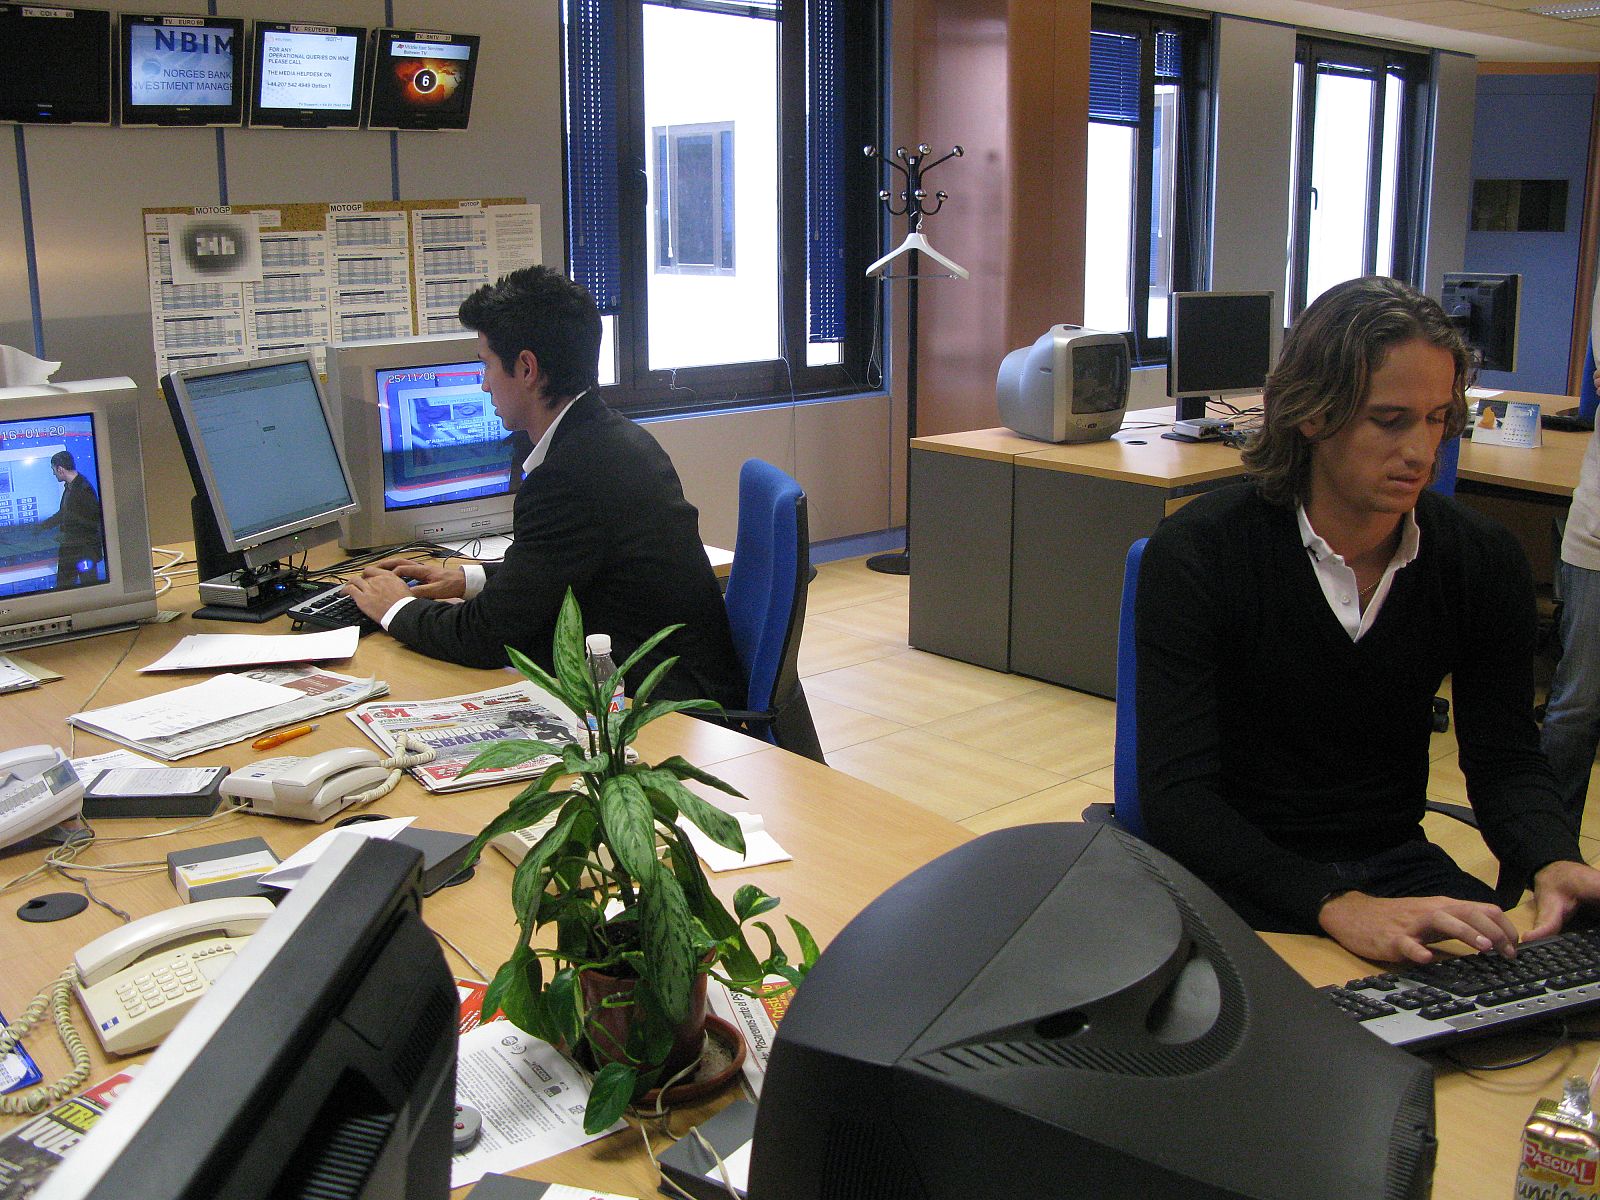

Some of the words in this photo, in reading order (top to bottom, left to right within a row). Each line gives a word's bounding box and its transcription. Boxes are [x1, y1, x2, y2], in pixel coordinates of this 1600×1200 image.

[154, 28, 232, 55] NBIM
[163, 69, 205, 79] NORGES
[207, 71, 232, 79] BANK
[422, 75, 430, 87] 6
[330, 204, 362, 212] MOTOGP
[388, 372, 436, 384] 25/11/08
[2, 425, 65, 441] 16:01:20
[82, 560, 89, 570] 1
[426, 730, 509, 749] SBALAR
